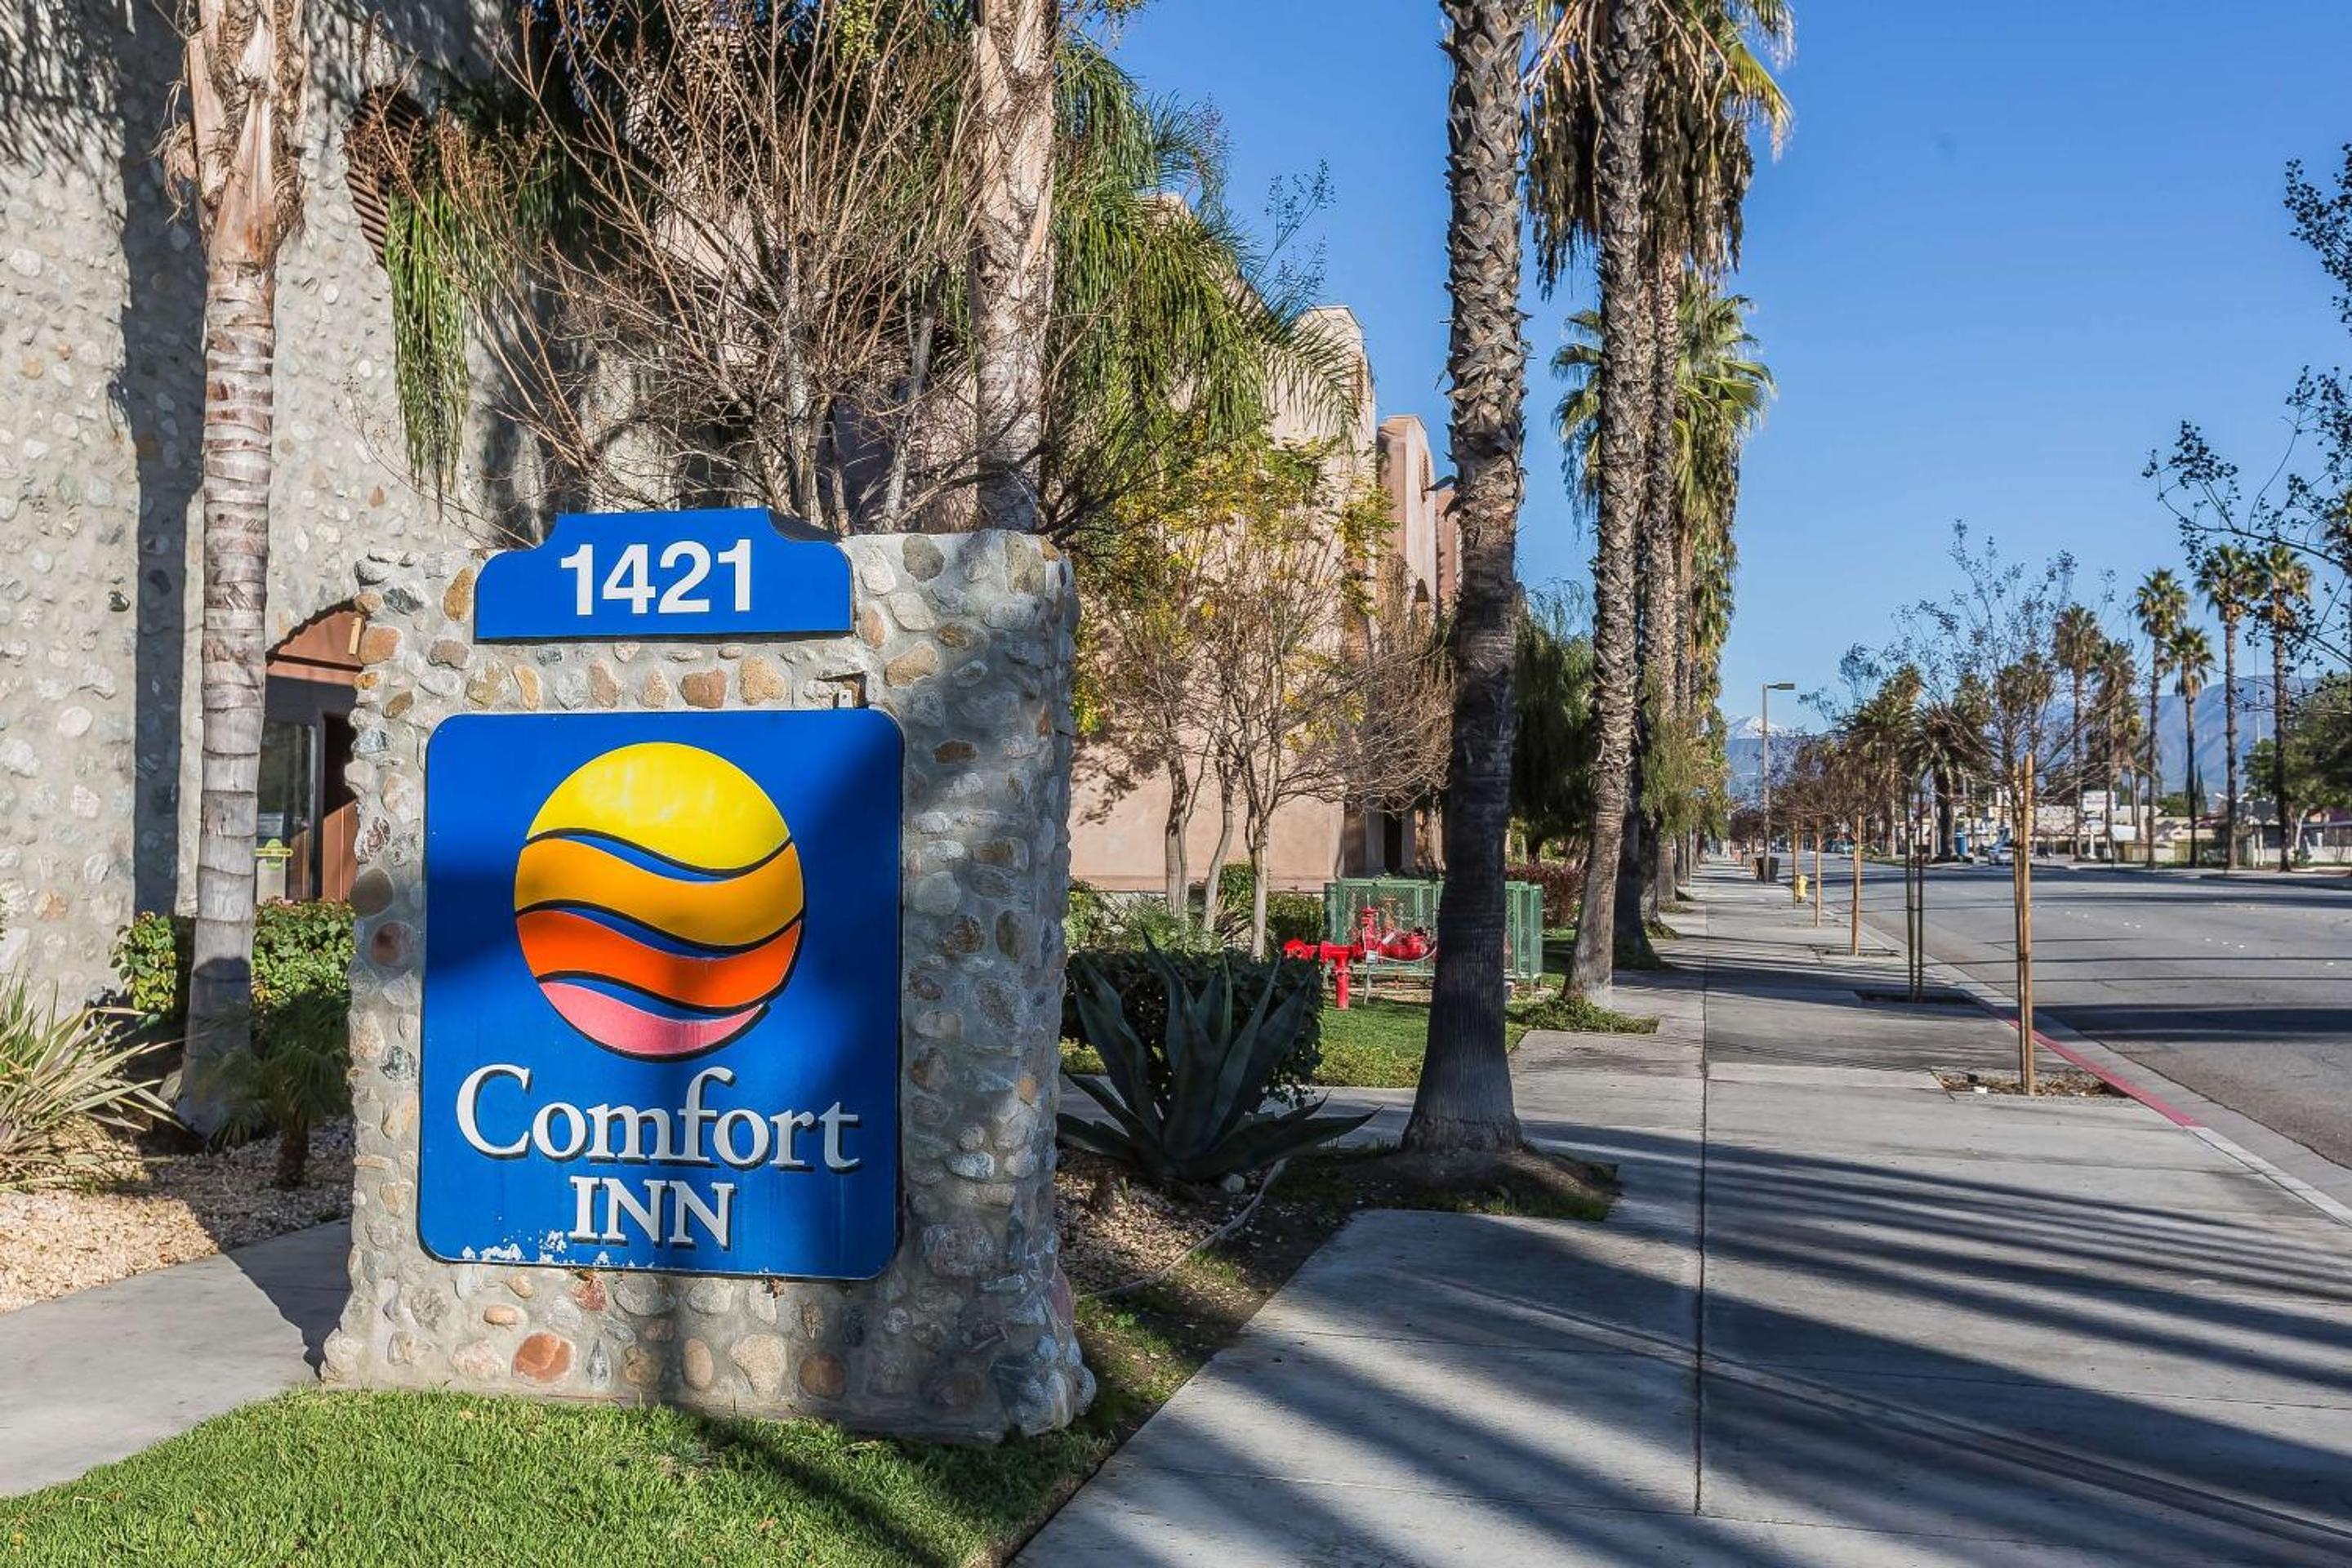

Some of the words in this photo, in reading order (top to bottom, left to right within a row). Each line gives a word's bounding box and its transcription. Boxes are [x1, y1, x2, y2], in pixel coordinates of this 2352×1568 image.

[559, 537, 751, 616] 1421
[456, 1063, 861, 1170] Comfort
[568, 1175, 737, 1250] INN
